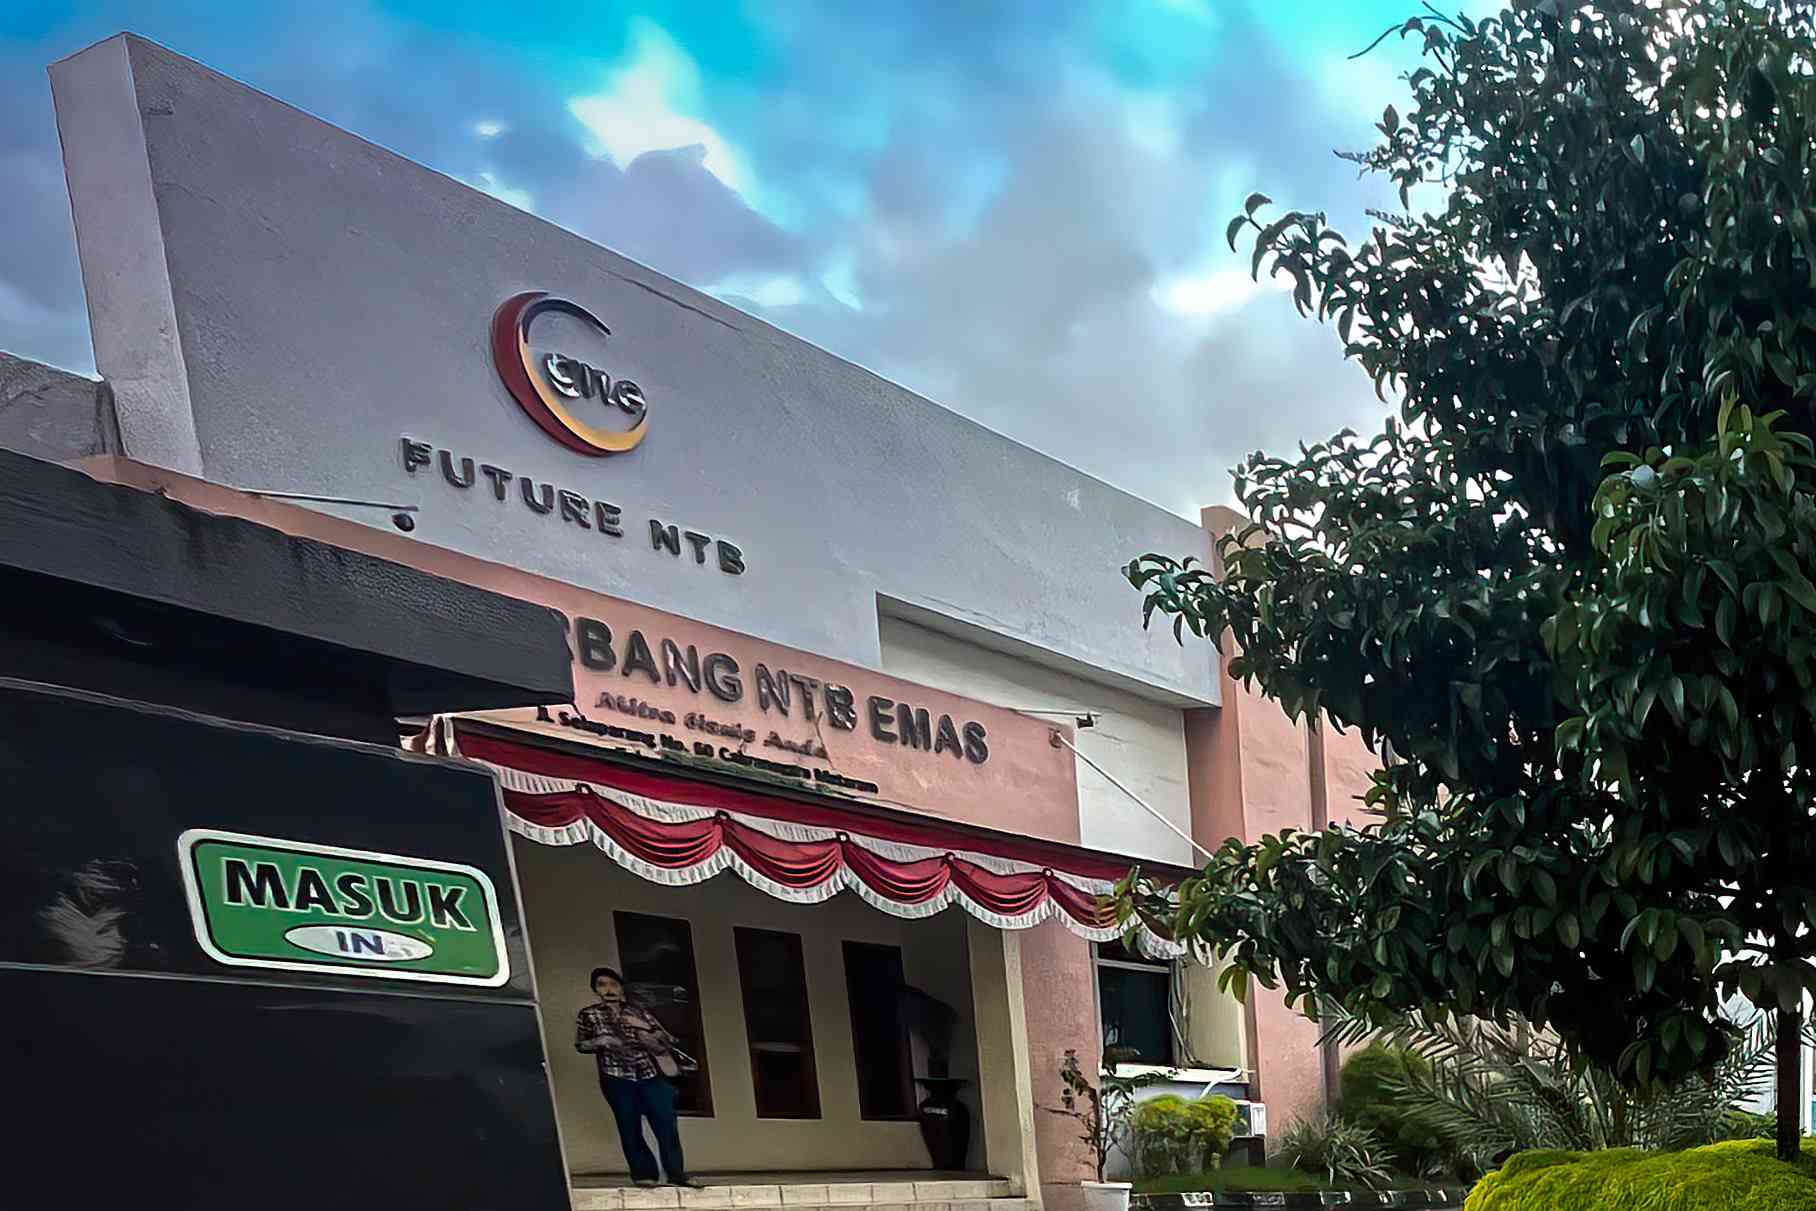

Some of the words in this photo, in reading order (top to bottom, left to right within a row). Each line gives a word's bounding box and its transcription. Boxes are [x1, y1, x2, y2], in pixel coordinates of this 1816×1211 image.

[401, 437, 624, 537] FUTURE
[650, 520, 745, 575] NTB
[562, 613, 744, 702] BANG
[755, 663, 858, 731] NTB
[868, 696, 989, 764] EMAS
[222, 857, 477, 932] MASUK
[336, 931, 385, 955] IN
